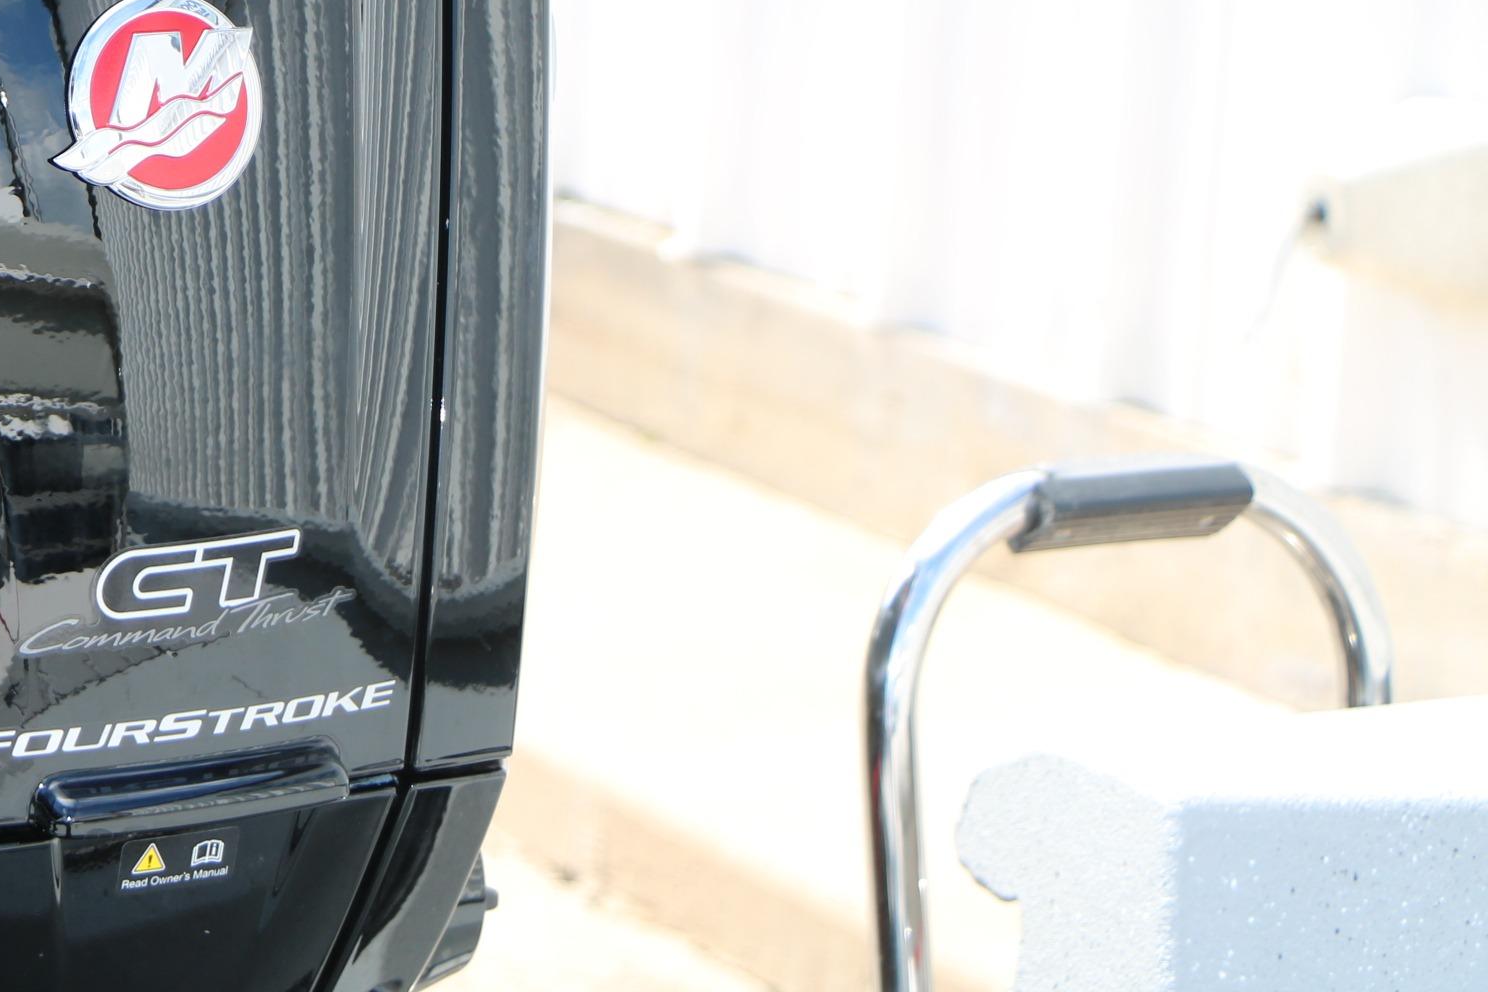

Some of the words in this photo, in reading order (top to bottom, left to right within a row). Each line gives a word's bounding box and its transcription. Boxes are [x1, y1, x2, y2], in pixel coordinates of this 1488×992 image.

[18, 610, 225, 655] Command
[228, 588, 356, 633] Thrust
[120, 877, 149, 890] Read
[150, 871, 191, 886] Owner's
[192, 865, 229, 880] Manual
